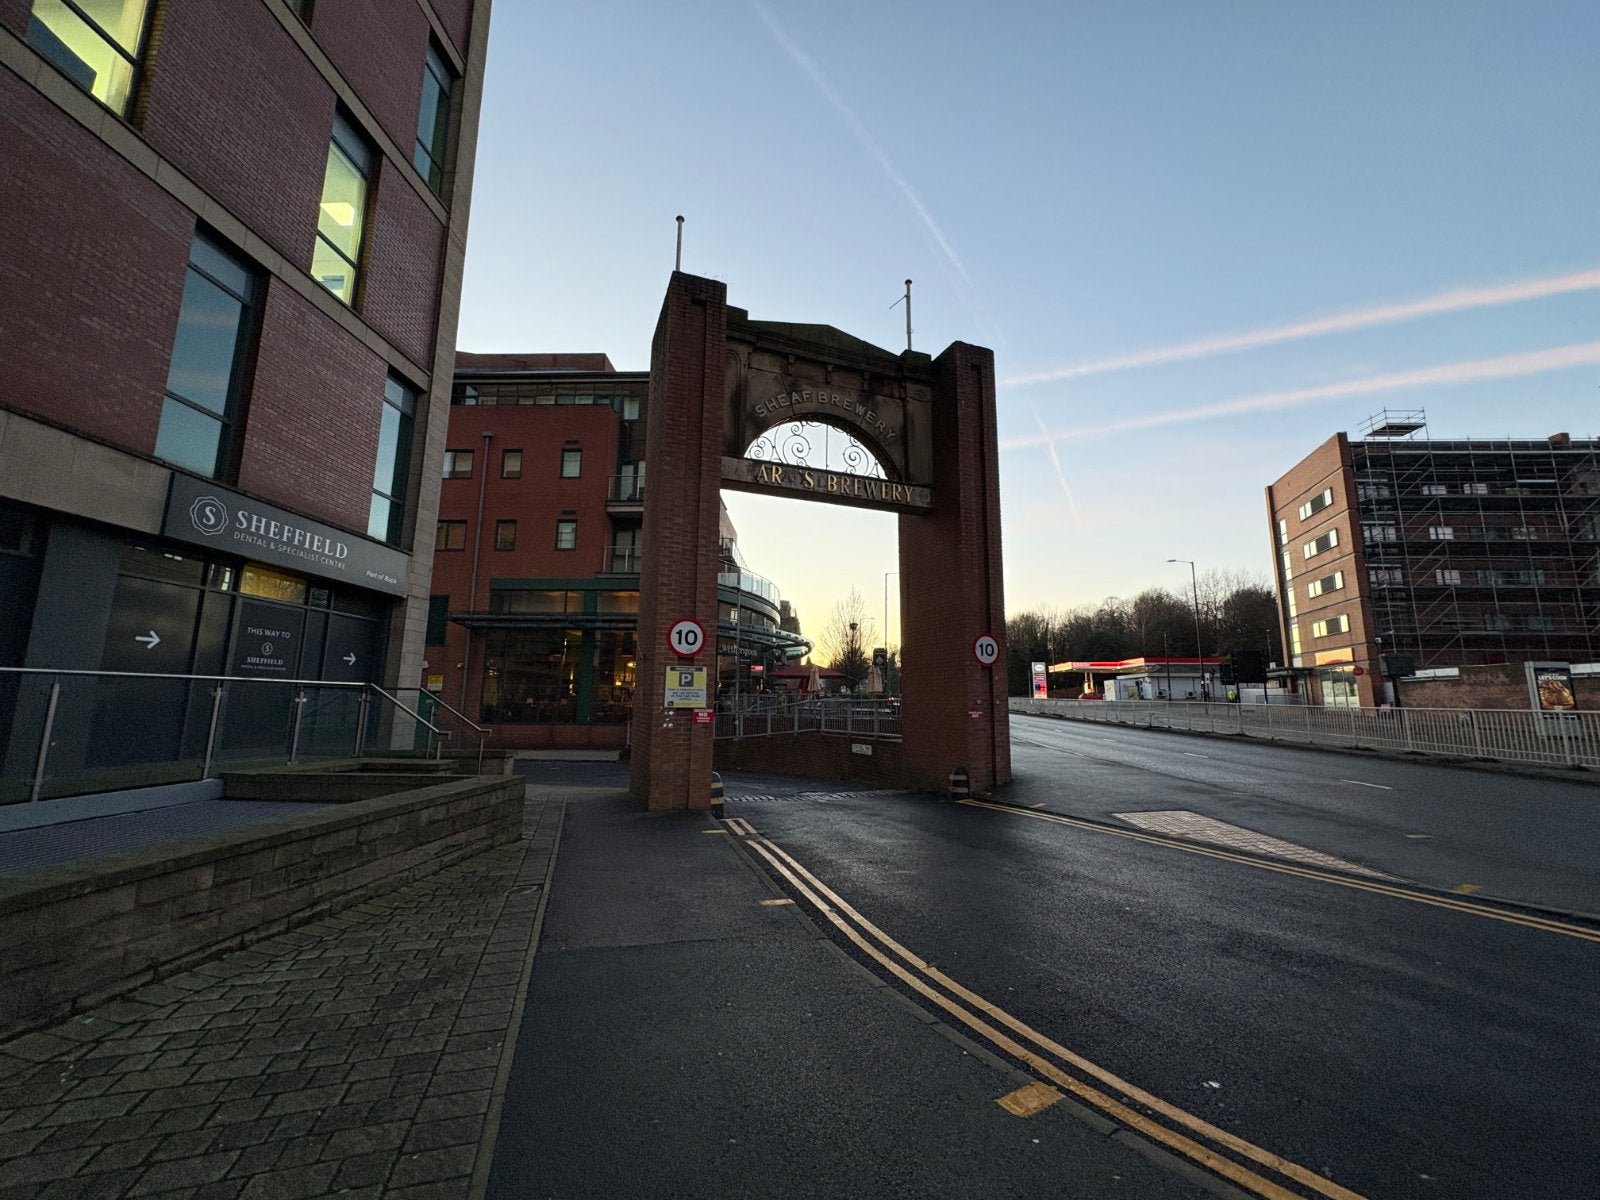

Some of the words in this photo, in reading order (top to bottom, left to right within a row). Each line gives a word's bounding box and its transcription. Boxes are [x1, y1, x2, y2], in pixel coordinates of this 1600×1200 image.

[754, 390, 813, 418] SHEAF
[818, 391, 897, 440] BREWERY
[827, 474, 914, 504] BREWERY
[235, 510, 348, 559] SHEFFIELD
[233, 531, 267, 548] DENTAL
[269, 541, 276, 550] &
[277, 543, 320, 563] SPECIALIST
[320, 555, 347, 571] CENTRE
[247, 626, 264, 636] THIS
[264, 629, 280, 638] WAY
[281, 631, 291, 639] TO
[676, 629, 698, 646] 10
[246, 656, 284, 666] SHEFFIELD
[979, 643, 995, 657] 10
